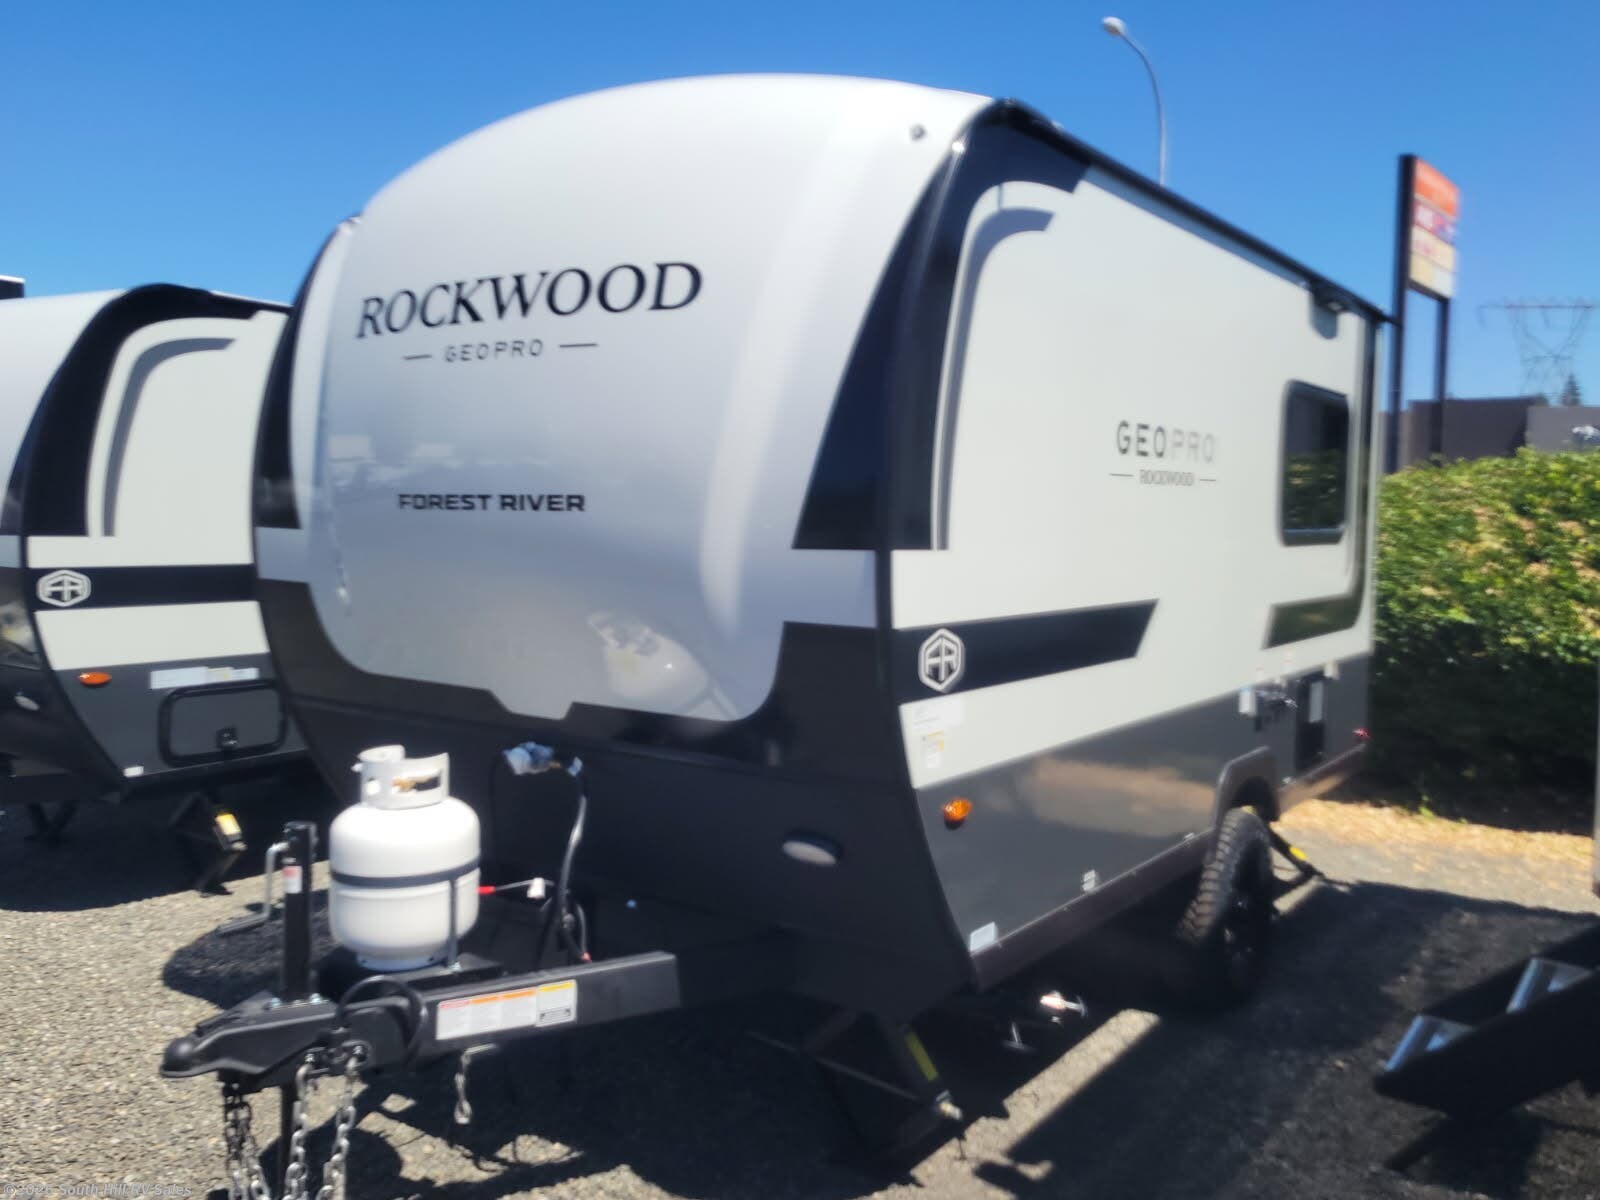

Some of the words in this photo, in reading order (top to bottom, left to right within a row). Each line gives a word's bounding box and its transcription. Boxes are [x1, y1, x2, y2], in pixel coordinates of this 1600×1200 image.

[355, 262, 703, 339] ROCKWOOD
[444, 339, 544, 362] GEOPRO
[1116, 420, 1215, 463] GEOPRO
[398, 494, 491, 510] FOREST
[500, 494, 586, 511] RIVER
